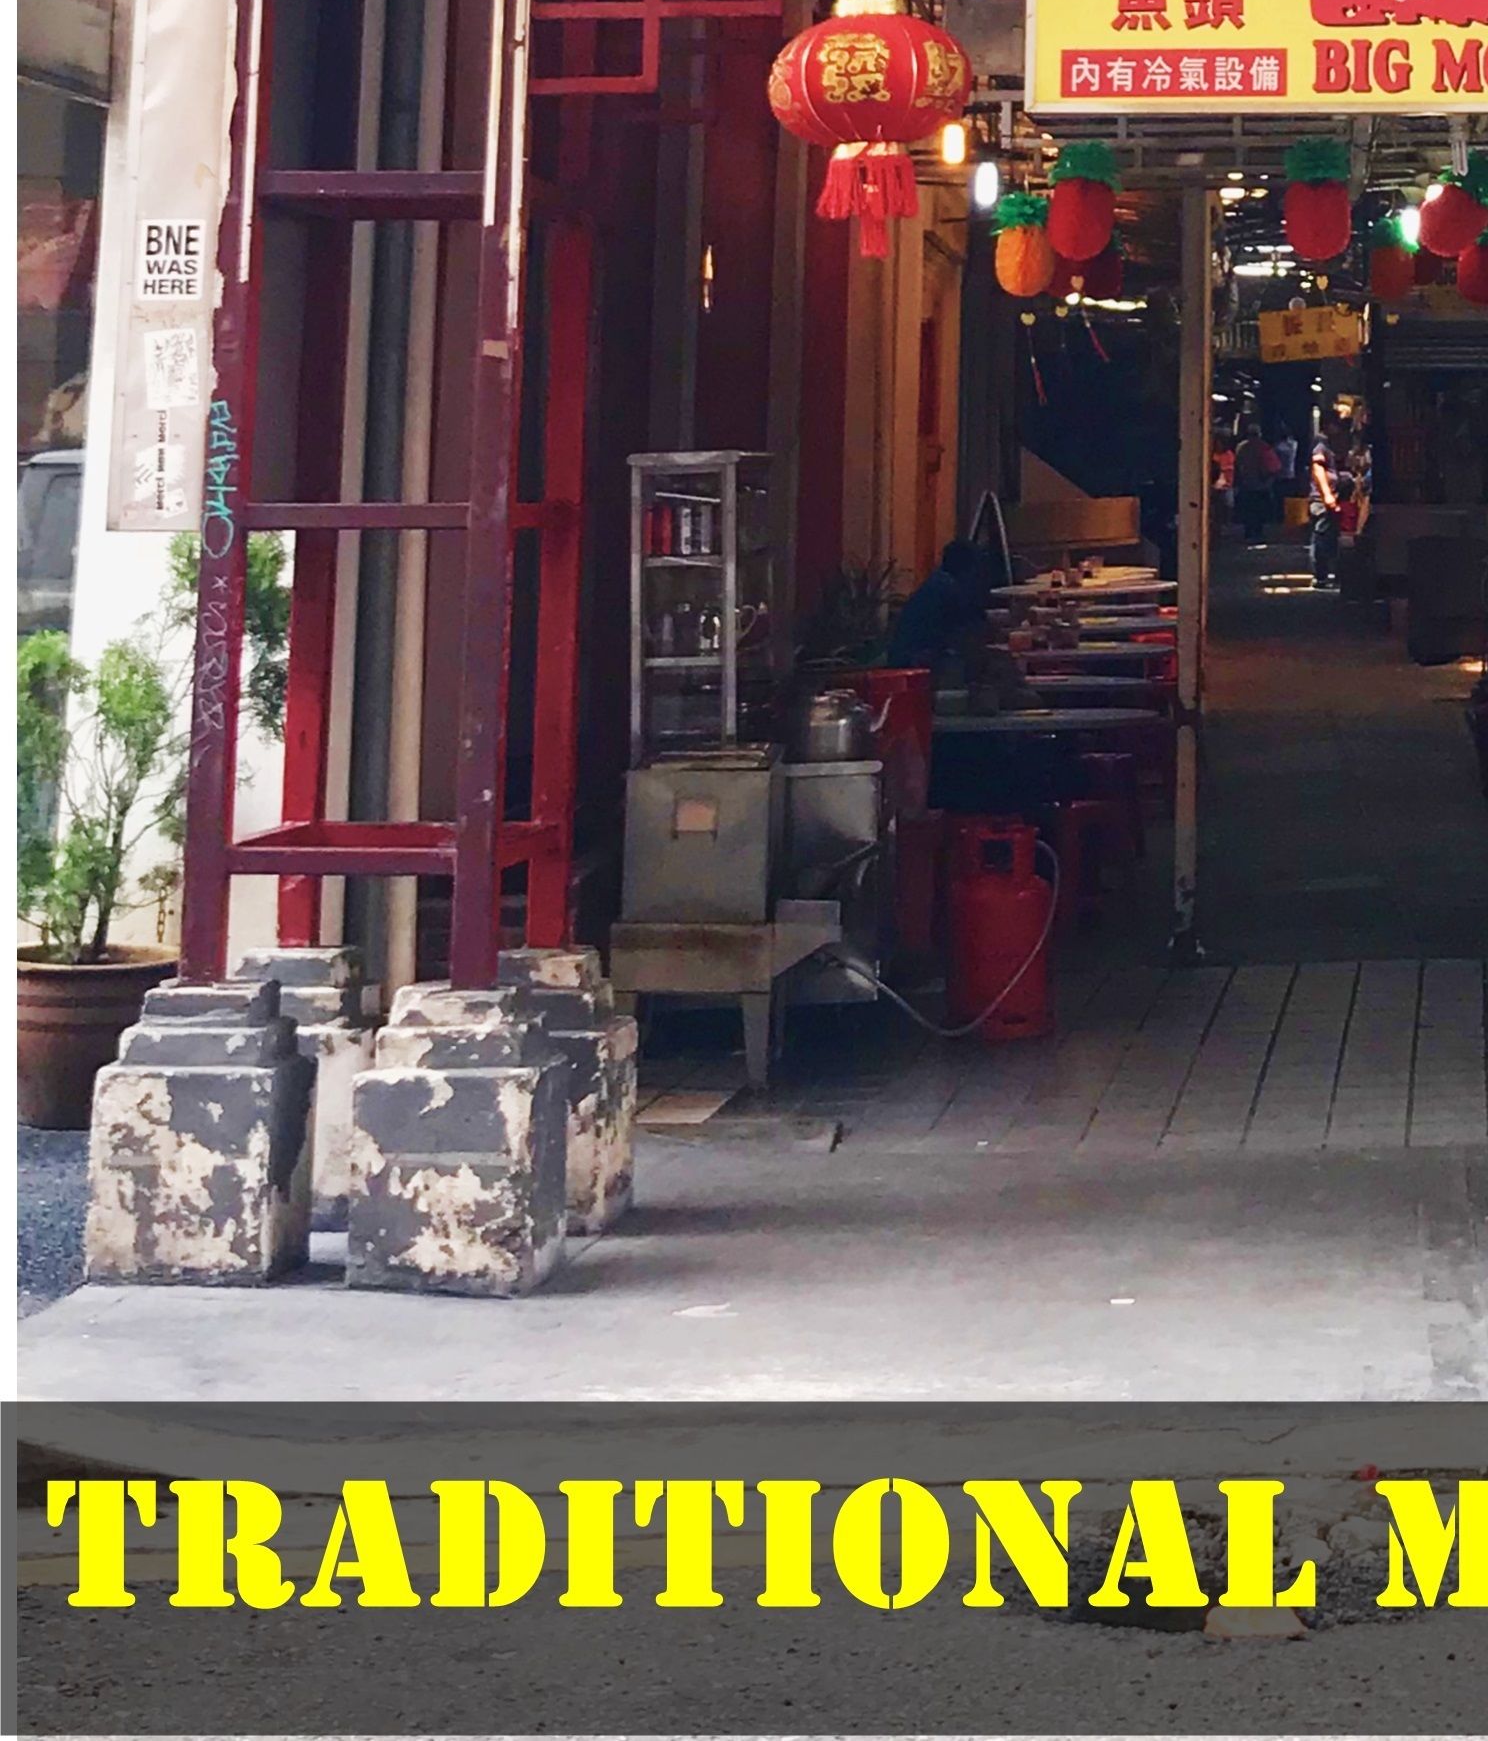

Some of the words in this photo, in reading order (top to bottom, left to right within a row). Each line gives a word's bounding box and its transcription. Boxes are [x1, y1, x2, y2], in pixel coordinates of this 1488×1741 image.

[1312, 38, 1414, 94] BIG
[145, 224, 200, 256] BNE
[145, 259, 198, 275] WAS
[143, 278, 197, 295] HERE
